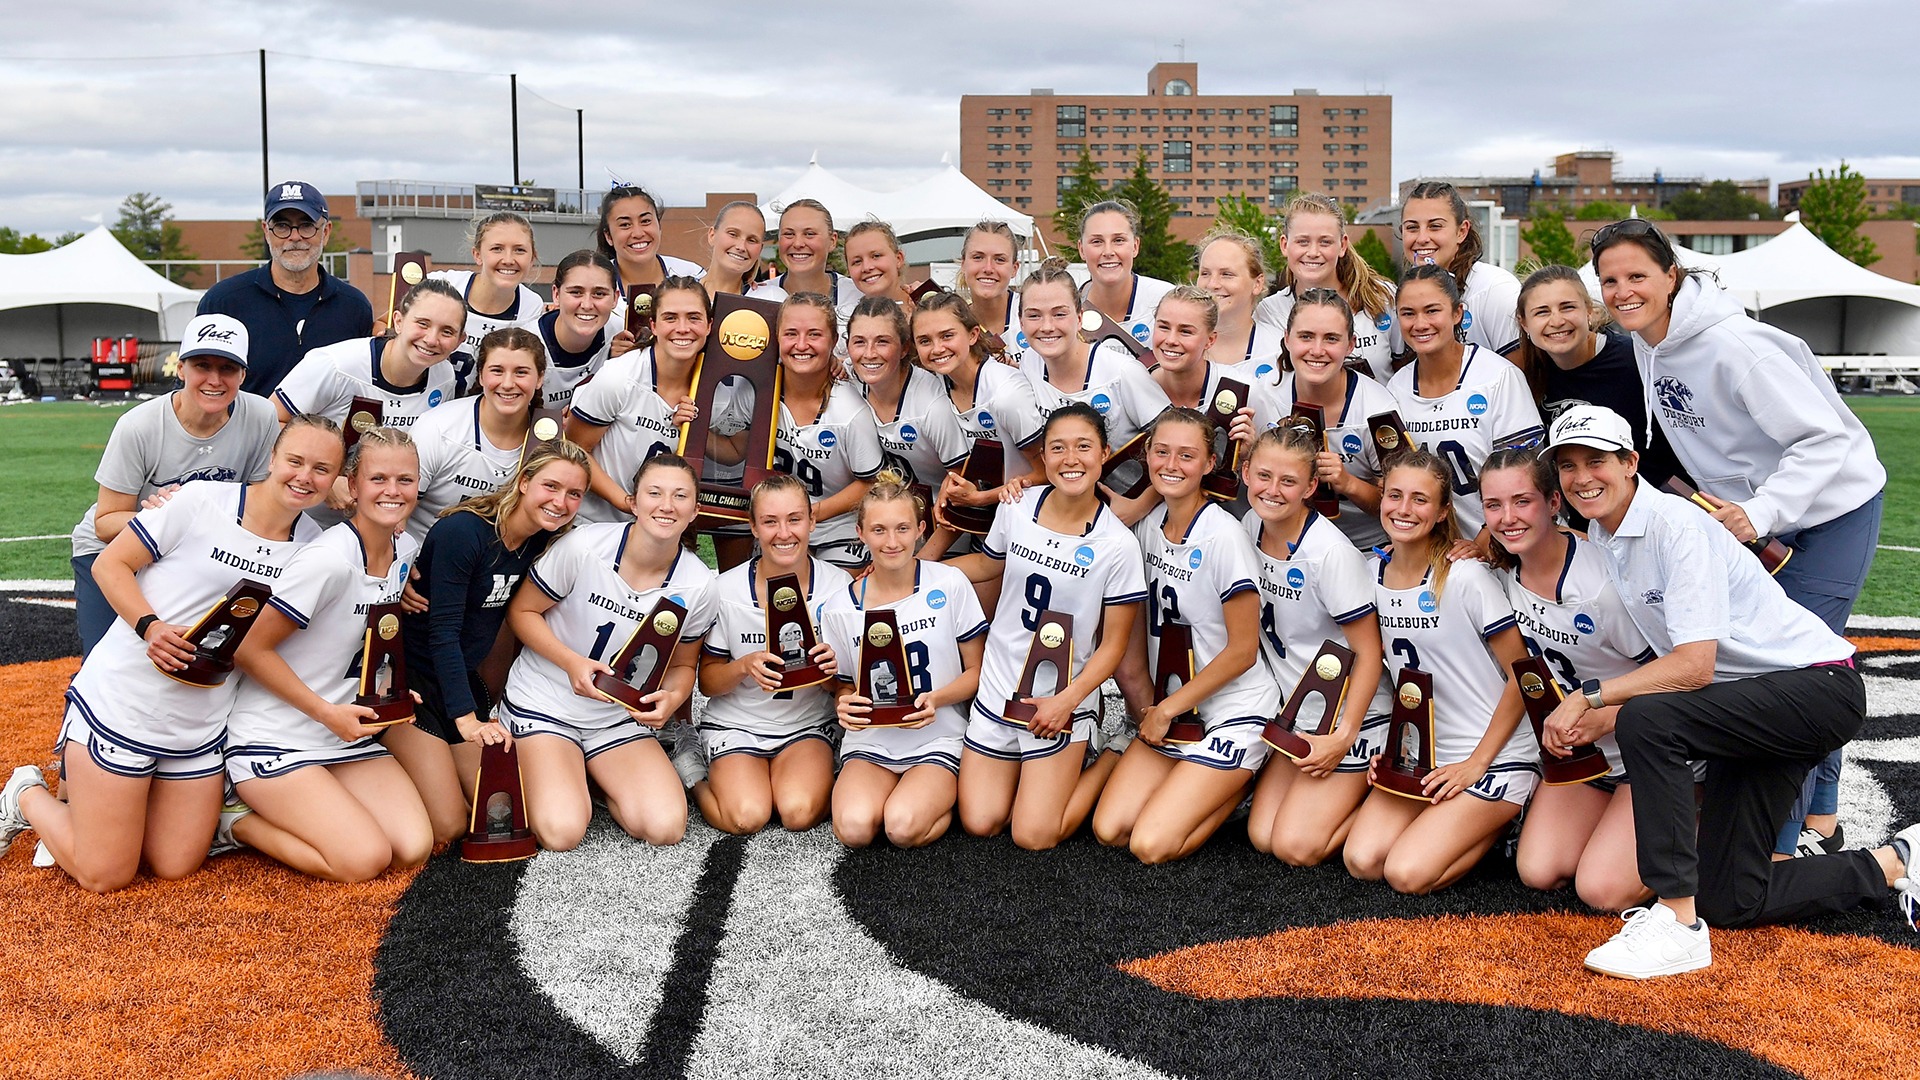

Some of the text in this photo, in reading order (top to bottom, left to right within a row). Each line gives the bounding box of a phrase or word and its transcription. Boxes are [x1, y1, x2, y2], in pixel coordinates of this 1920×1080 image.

[281, 184, 302, 197] M
[720, 331, 767, 351] NCAA
[210, 547, 283, 579] MIDDLEBU
[1010, 542, 1090, 579] MIDDLEBURY
[485, 574, 520, 602] M
[1021, 572, 1053, 632] 9
[588, 592, 645, 622] MIDDLEB
